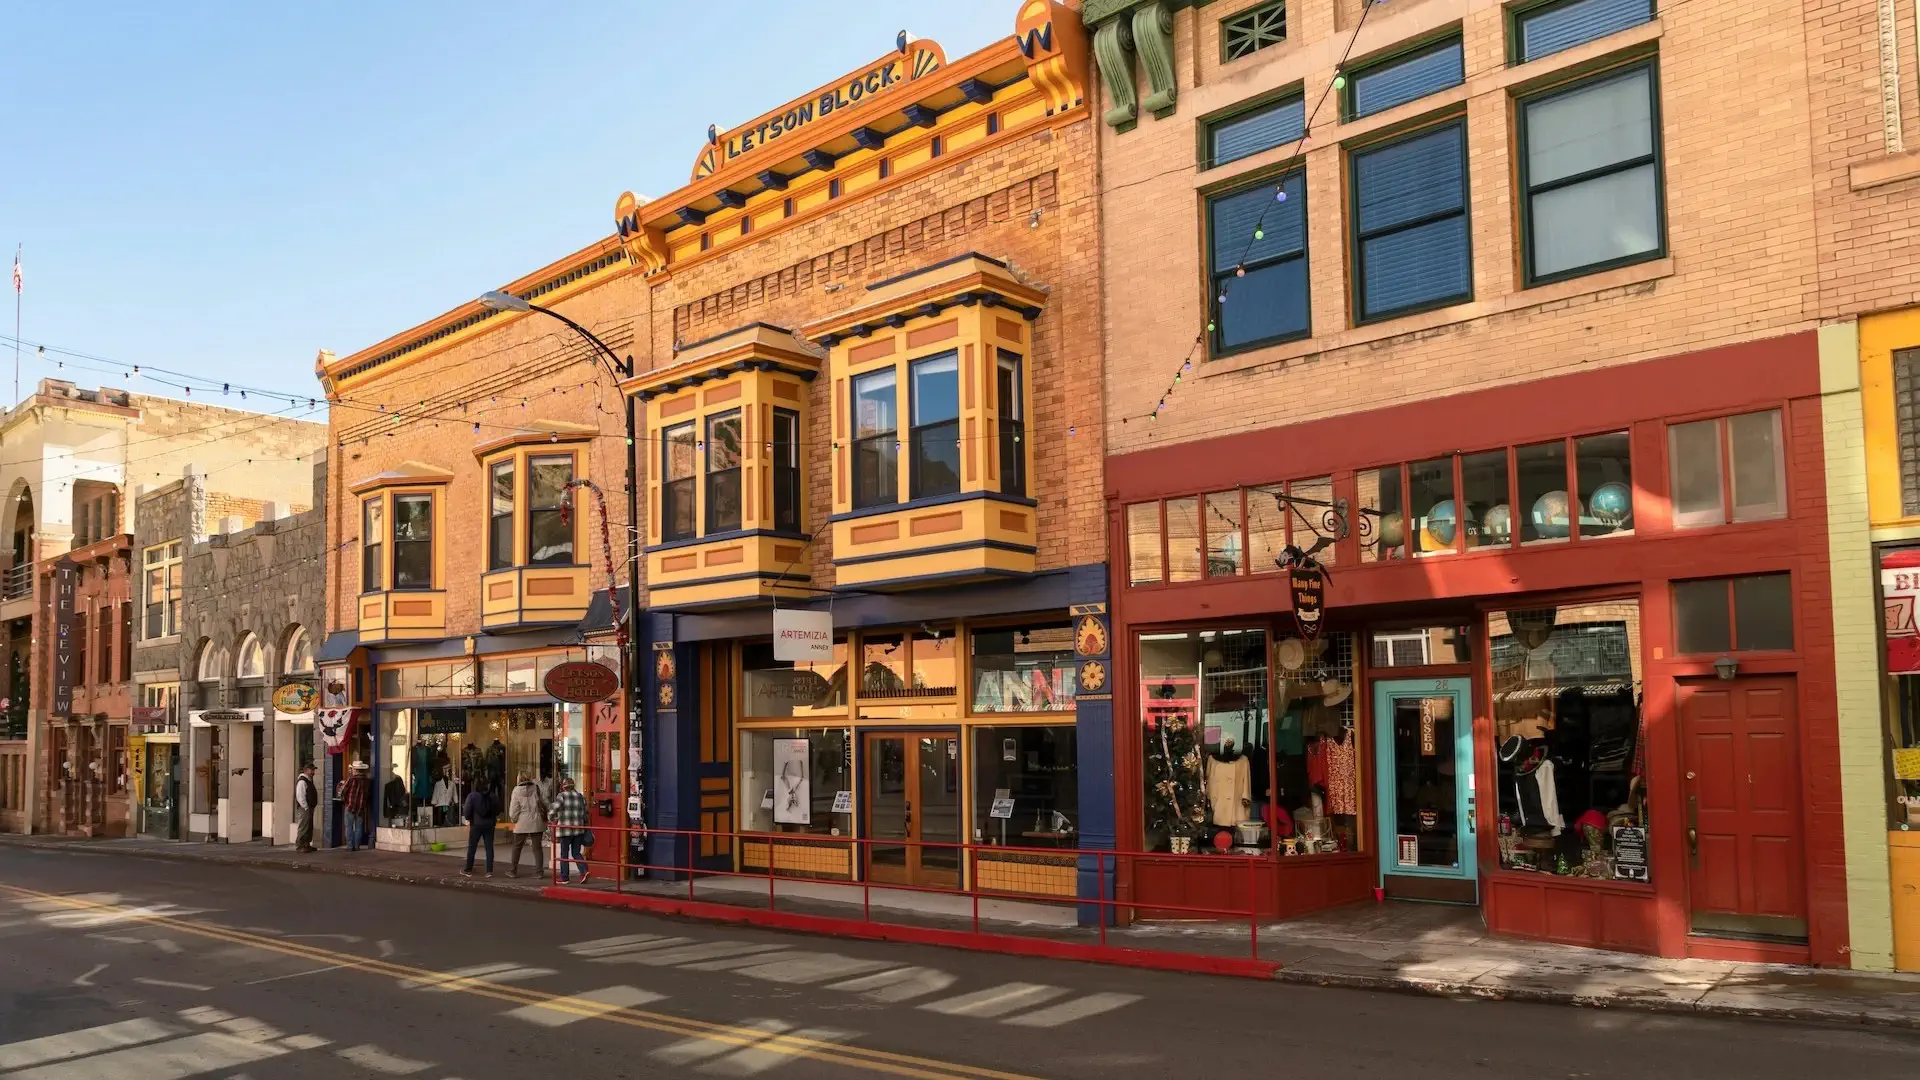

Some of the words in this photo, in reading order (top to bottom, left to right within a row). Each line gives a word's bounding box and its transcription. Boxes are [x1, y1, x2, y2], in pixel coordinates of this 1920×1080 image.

[728, 102, 814, 159] LETSON
[818, 62, 902, 117] BLOCK.
[61, 568, 72, 610] THE
[1297, 592, 1318, 605] Things
[780, 630, 828, 640] ARTEMIZIA
[56, 623, 70, 712] REVIEW
[561, 667, 605, 677] LETSON
[567, 687, 601, 697] HOTEL
